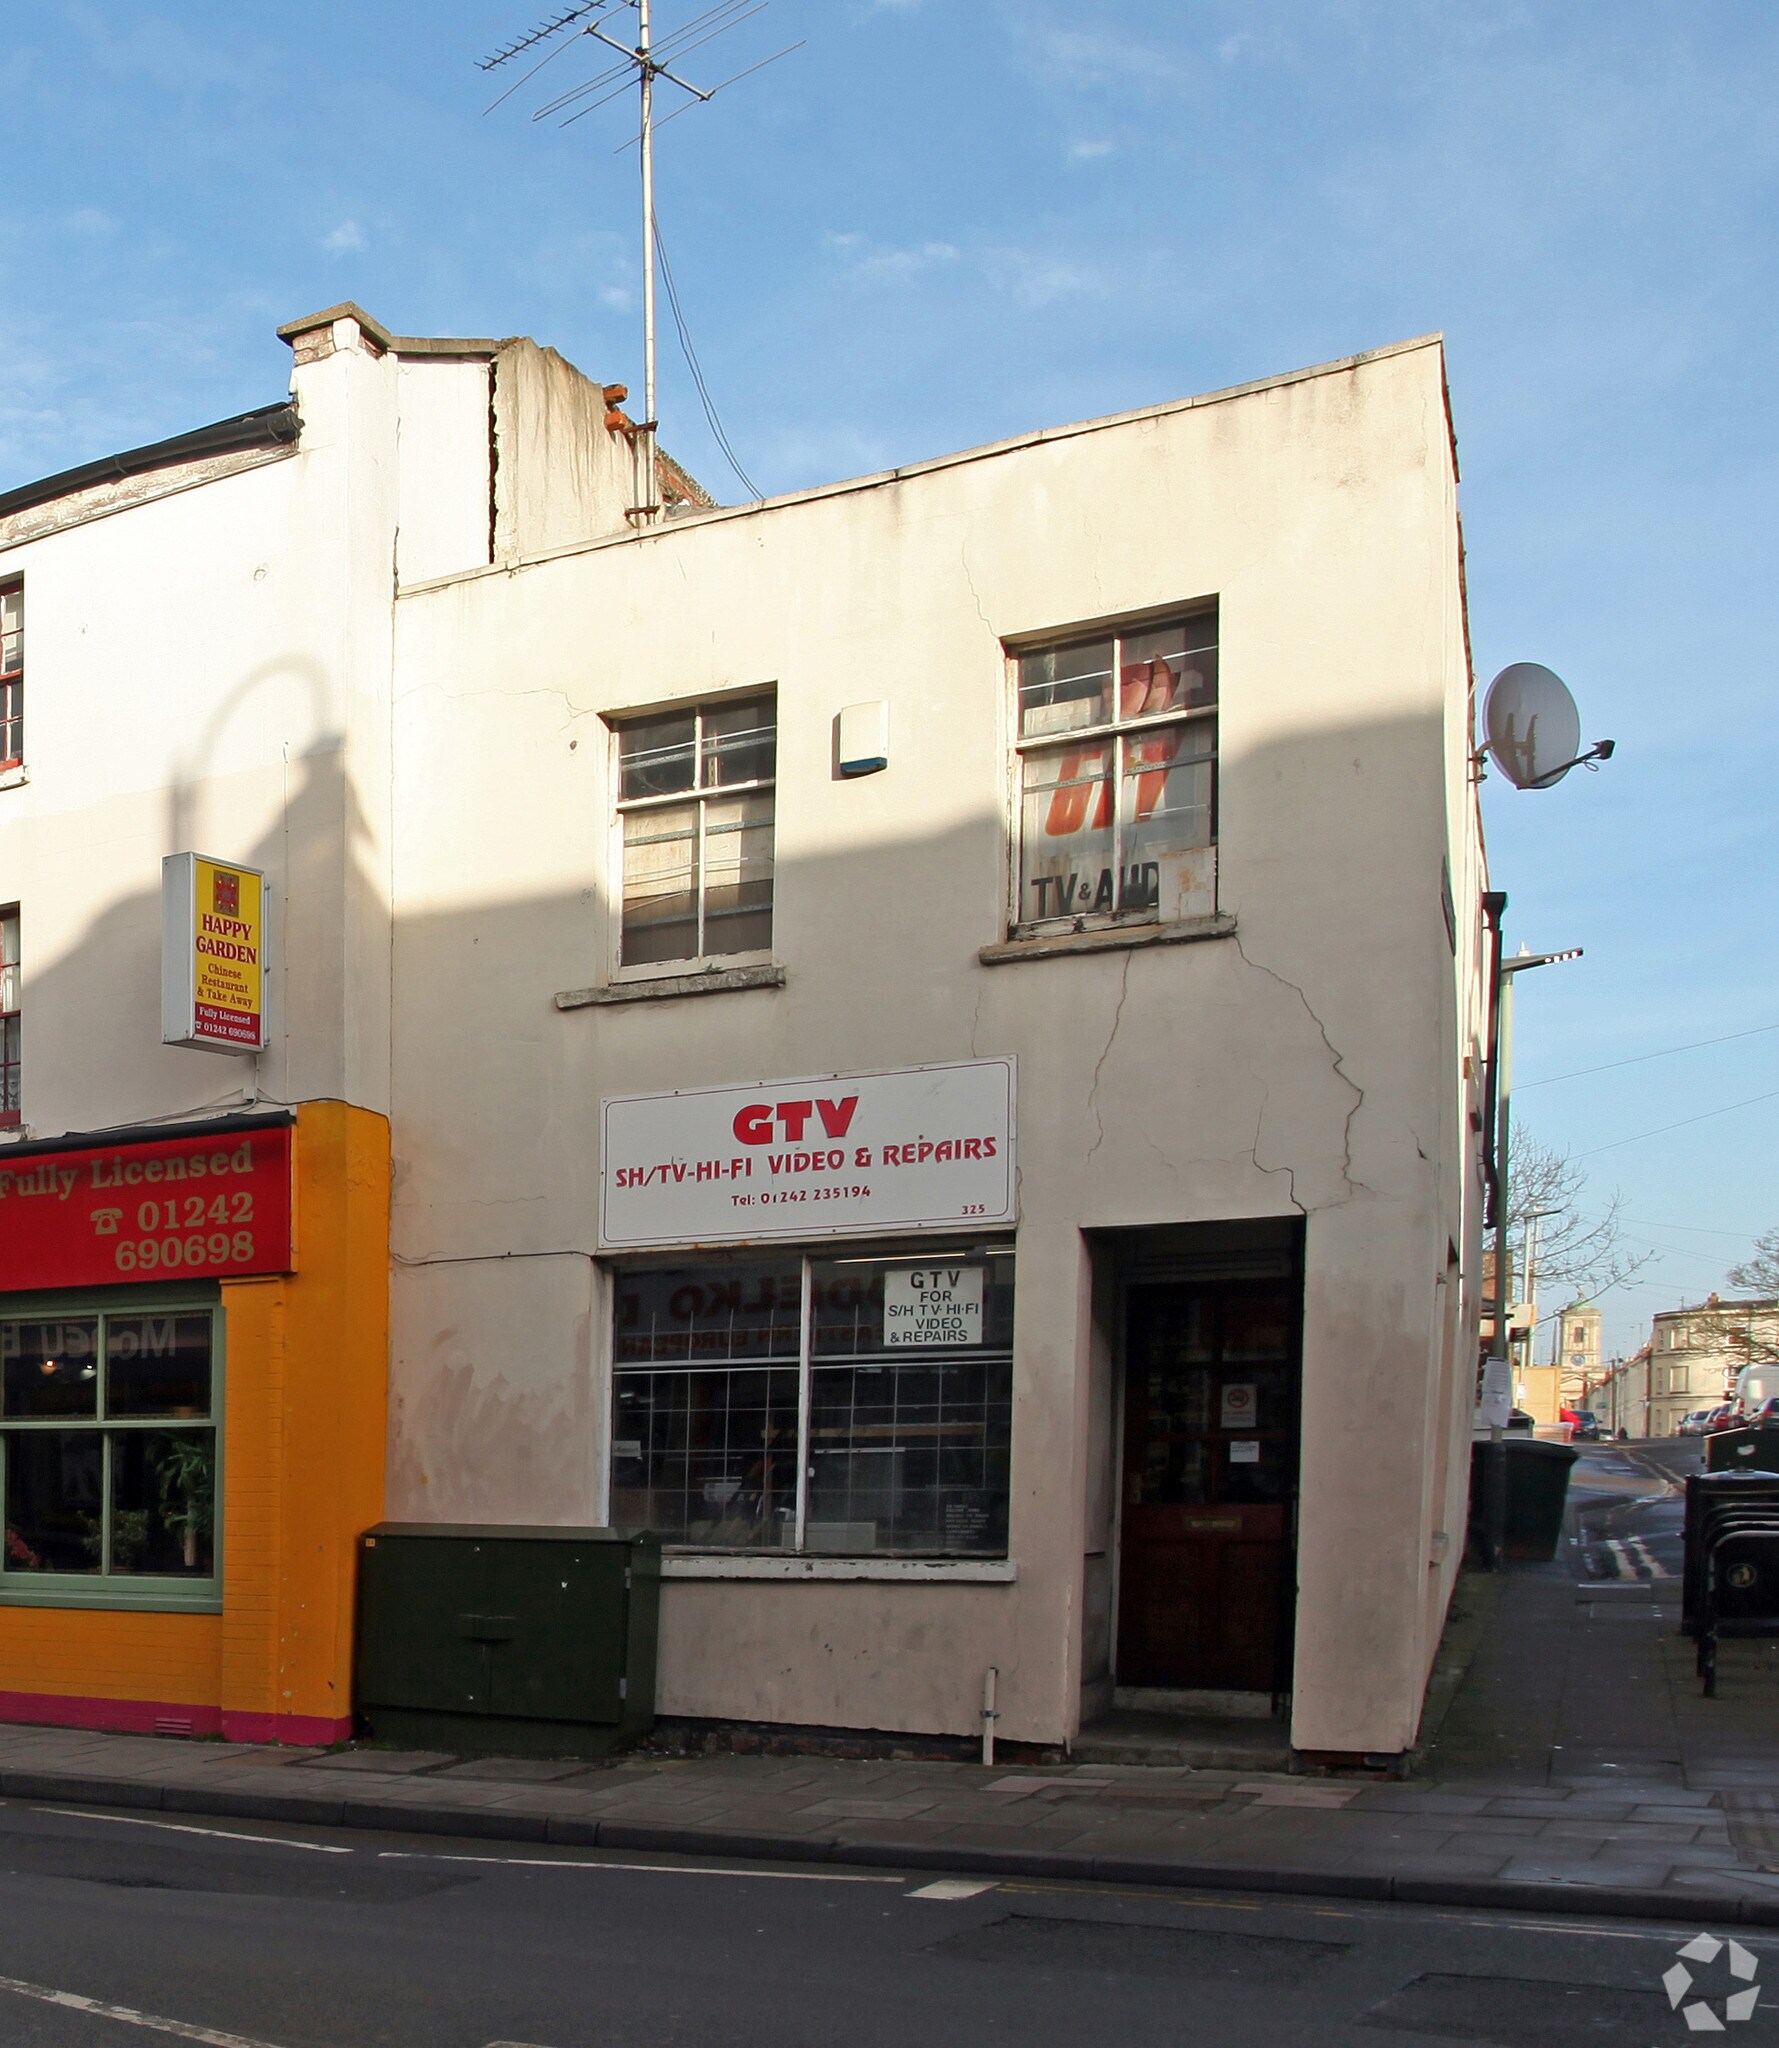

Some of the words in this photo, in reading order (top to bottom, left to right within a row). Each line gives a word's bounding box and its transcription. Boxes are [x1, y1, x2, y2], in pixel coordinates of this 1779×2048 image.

[1031, 872, 1078, 918] TV
[1078, 882, 1091, 901] &
[202, 913, 252, 941] HAPPY
[195, 935, 257, 964] GARDEN
[208, 963, 242, 979] Chinese
[201, 974, 249, 993] Restaurant
[197, 986, 204, 997] &
[206, 988, 228, 1001] Take
[230, 994, 253, 1009] Away
[199, 1006, 218, 1020] Fully
[219, 1011, 251, 1025] Licensed
[203, 1022, 227, 1035] 01242
[732, 1096, 859, 1146] GTV
[0, 1163, 79, 1201] Fully
[90, 1141, 254, 1190] Licensed
[616, 1157, 752, 1189] SH/TV-HI-FI
[767, 1149, 845, 1175] VIDEO
[854, 1147, 872, 1167] &
[882, 1137, 998, 1167] REPAIRS
[731, 1194, 757, 1207] Tel:
[760, 1190, 808, 1205] 01242
[813, 1185, 872, 1202] 235194
[137, 1191, 254, 1232] 01242
[961, 1204, 986, 1216] 325
[115, 1230, 255, 1272] 690698
[910, 1270, 960, 1289] GTV
[920, 1290, 952, 1302] FOR
[888, 1304, 914, 1317] S/H
[915, 1317, 962, 1329] VIDEO
[890, 1331, 899, 1343] &
[903, 1329, 968, 1343] REPAIRS
